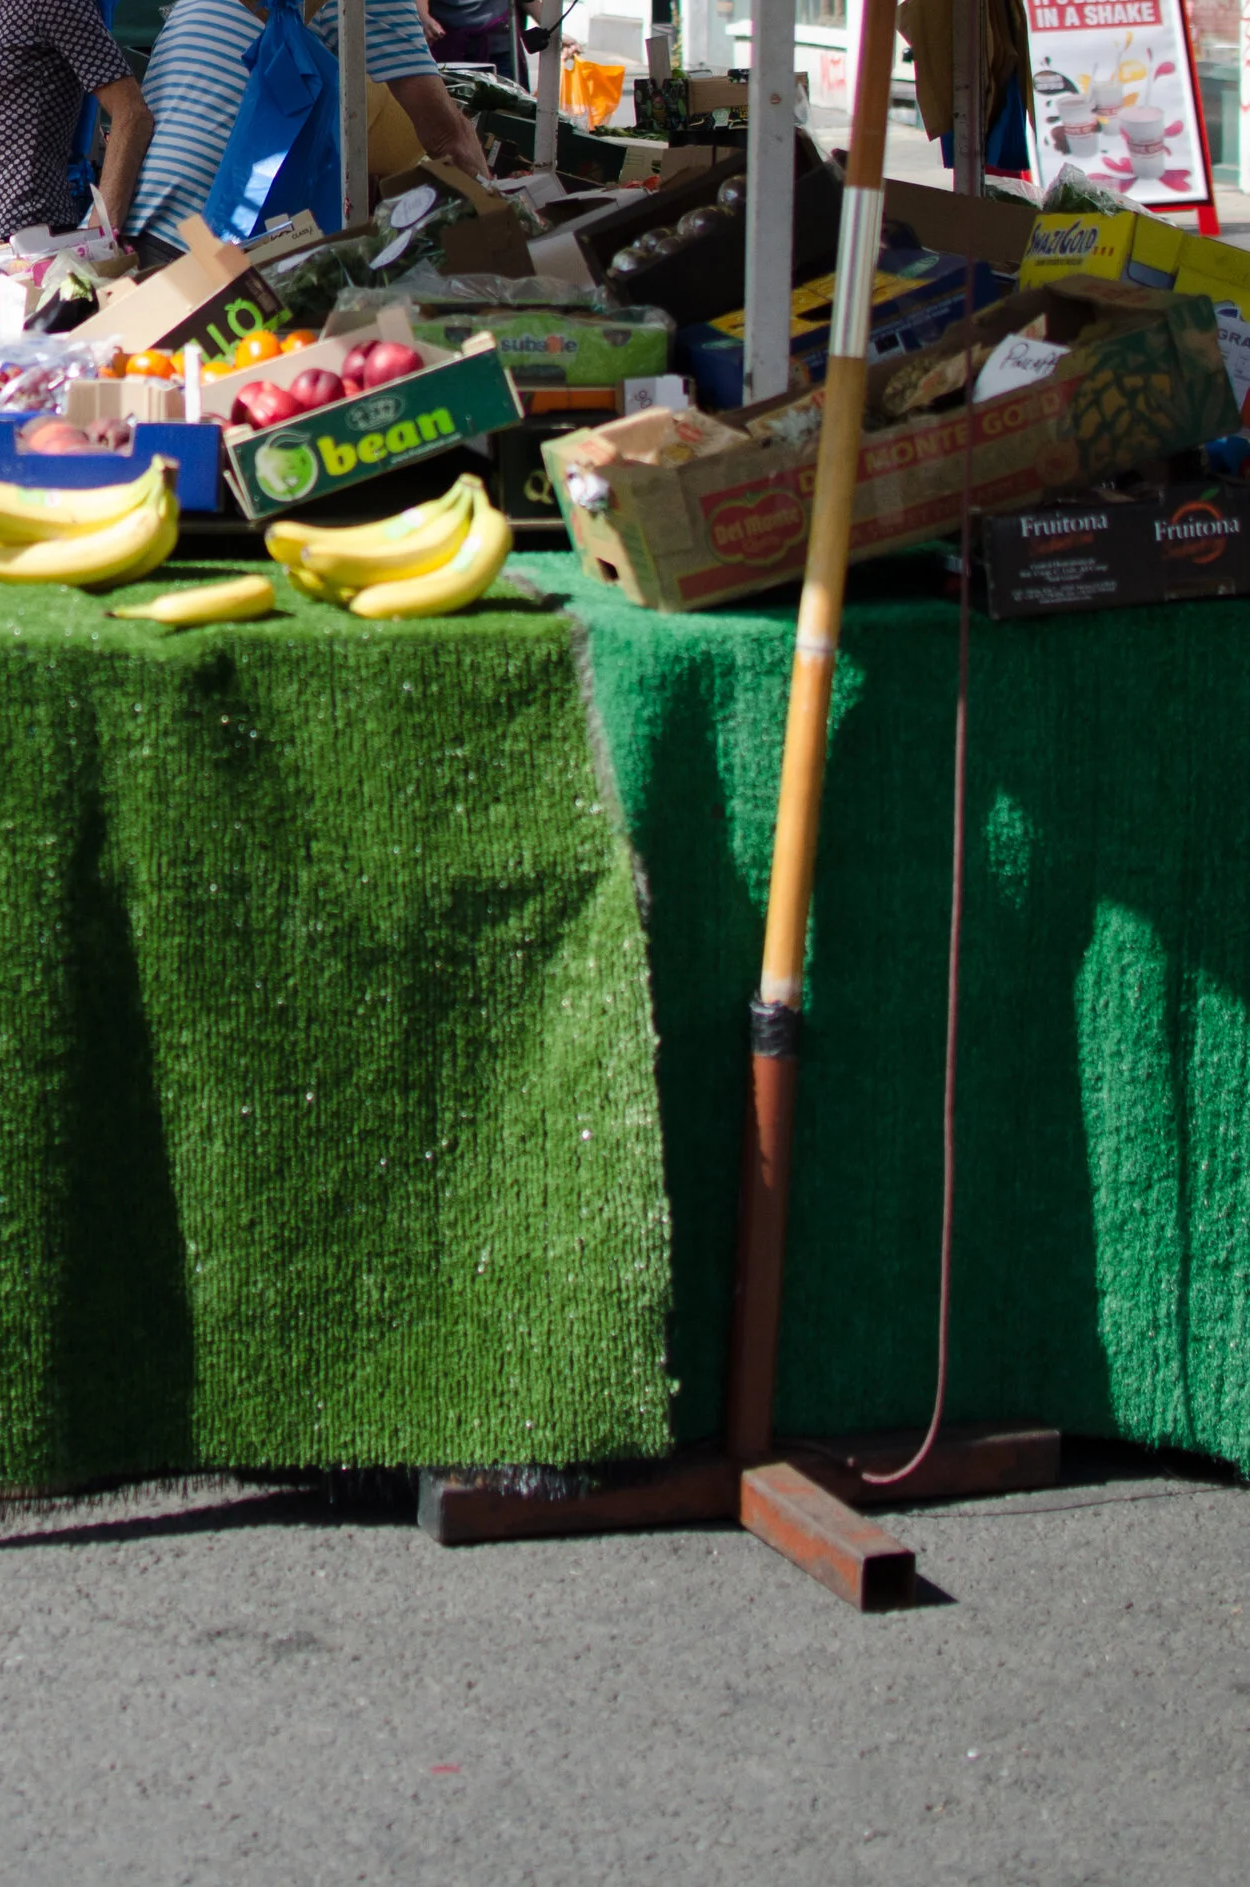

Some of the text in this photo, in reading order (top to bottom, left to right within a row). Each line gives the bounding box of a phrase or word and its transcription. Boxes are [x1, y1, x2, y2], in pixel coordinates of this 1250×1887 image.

[1036, 1, 1156, 29] IN A SHAKE
[316, 407, 456, 477] bean
[863, 422, 971, 473] MONTE
[1020, 510, 1109, 538] Fruitona
[1154, 516, 1241, 542] Fruitona
